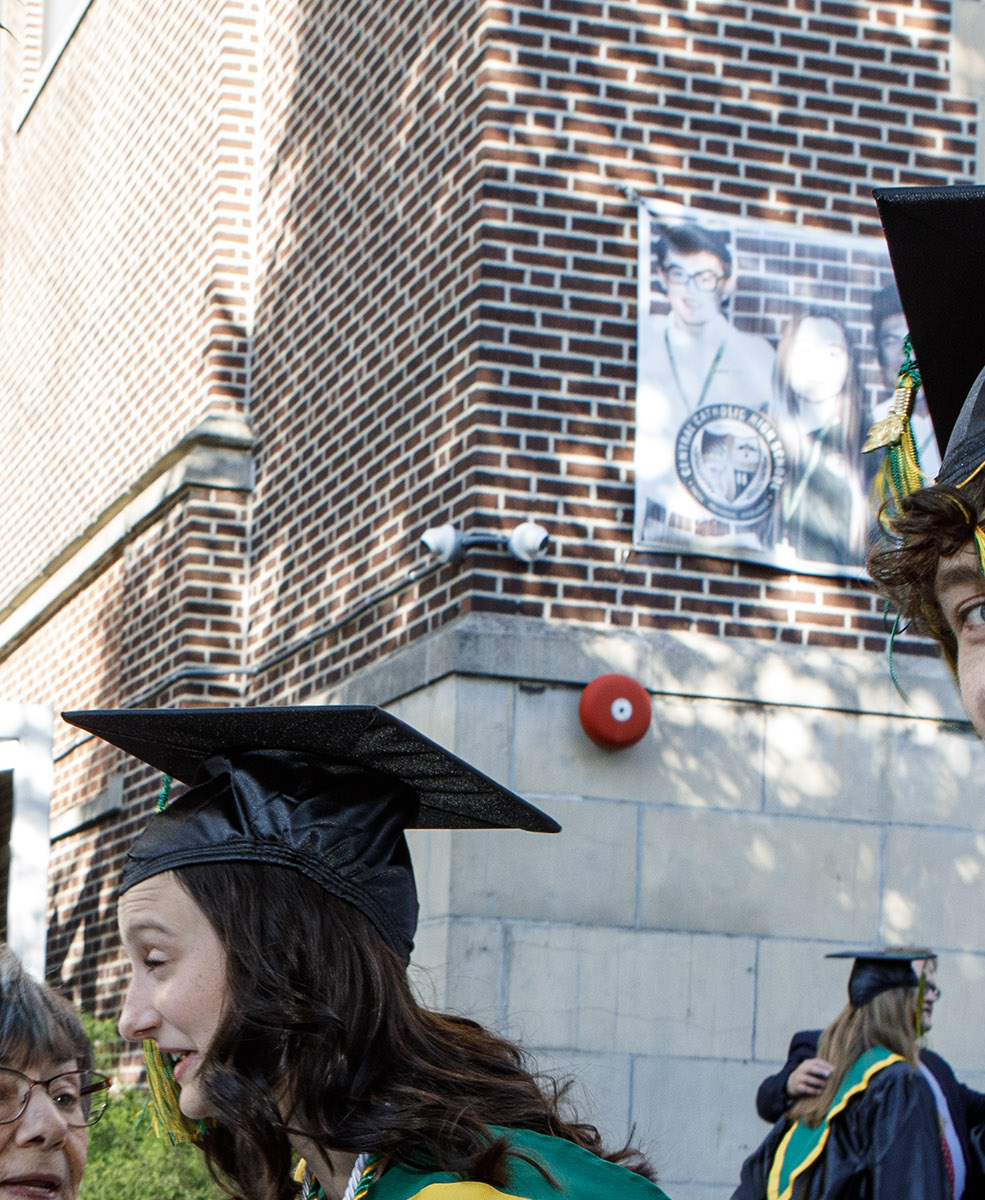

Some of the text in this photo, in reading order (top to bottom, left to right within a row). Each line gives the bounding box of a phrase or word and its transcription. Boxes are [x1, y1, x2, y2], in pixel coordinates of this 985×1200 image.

[693, 406, 747, 424] CATHOLIC
[749, 413, 777, 441] HIGH
[770, 440, 786, 489] SCHOOL
